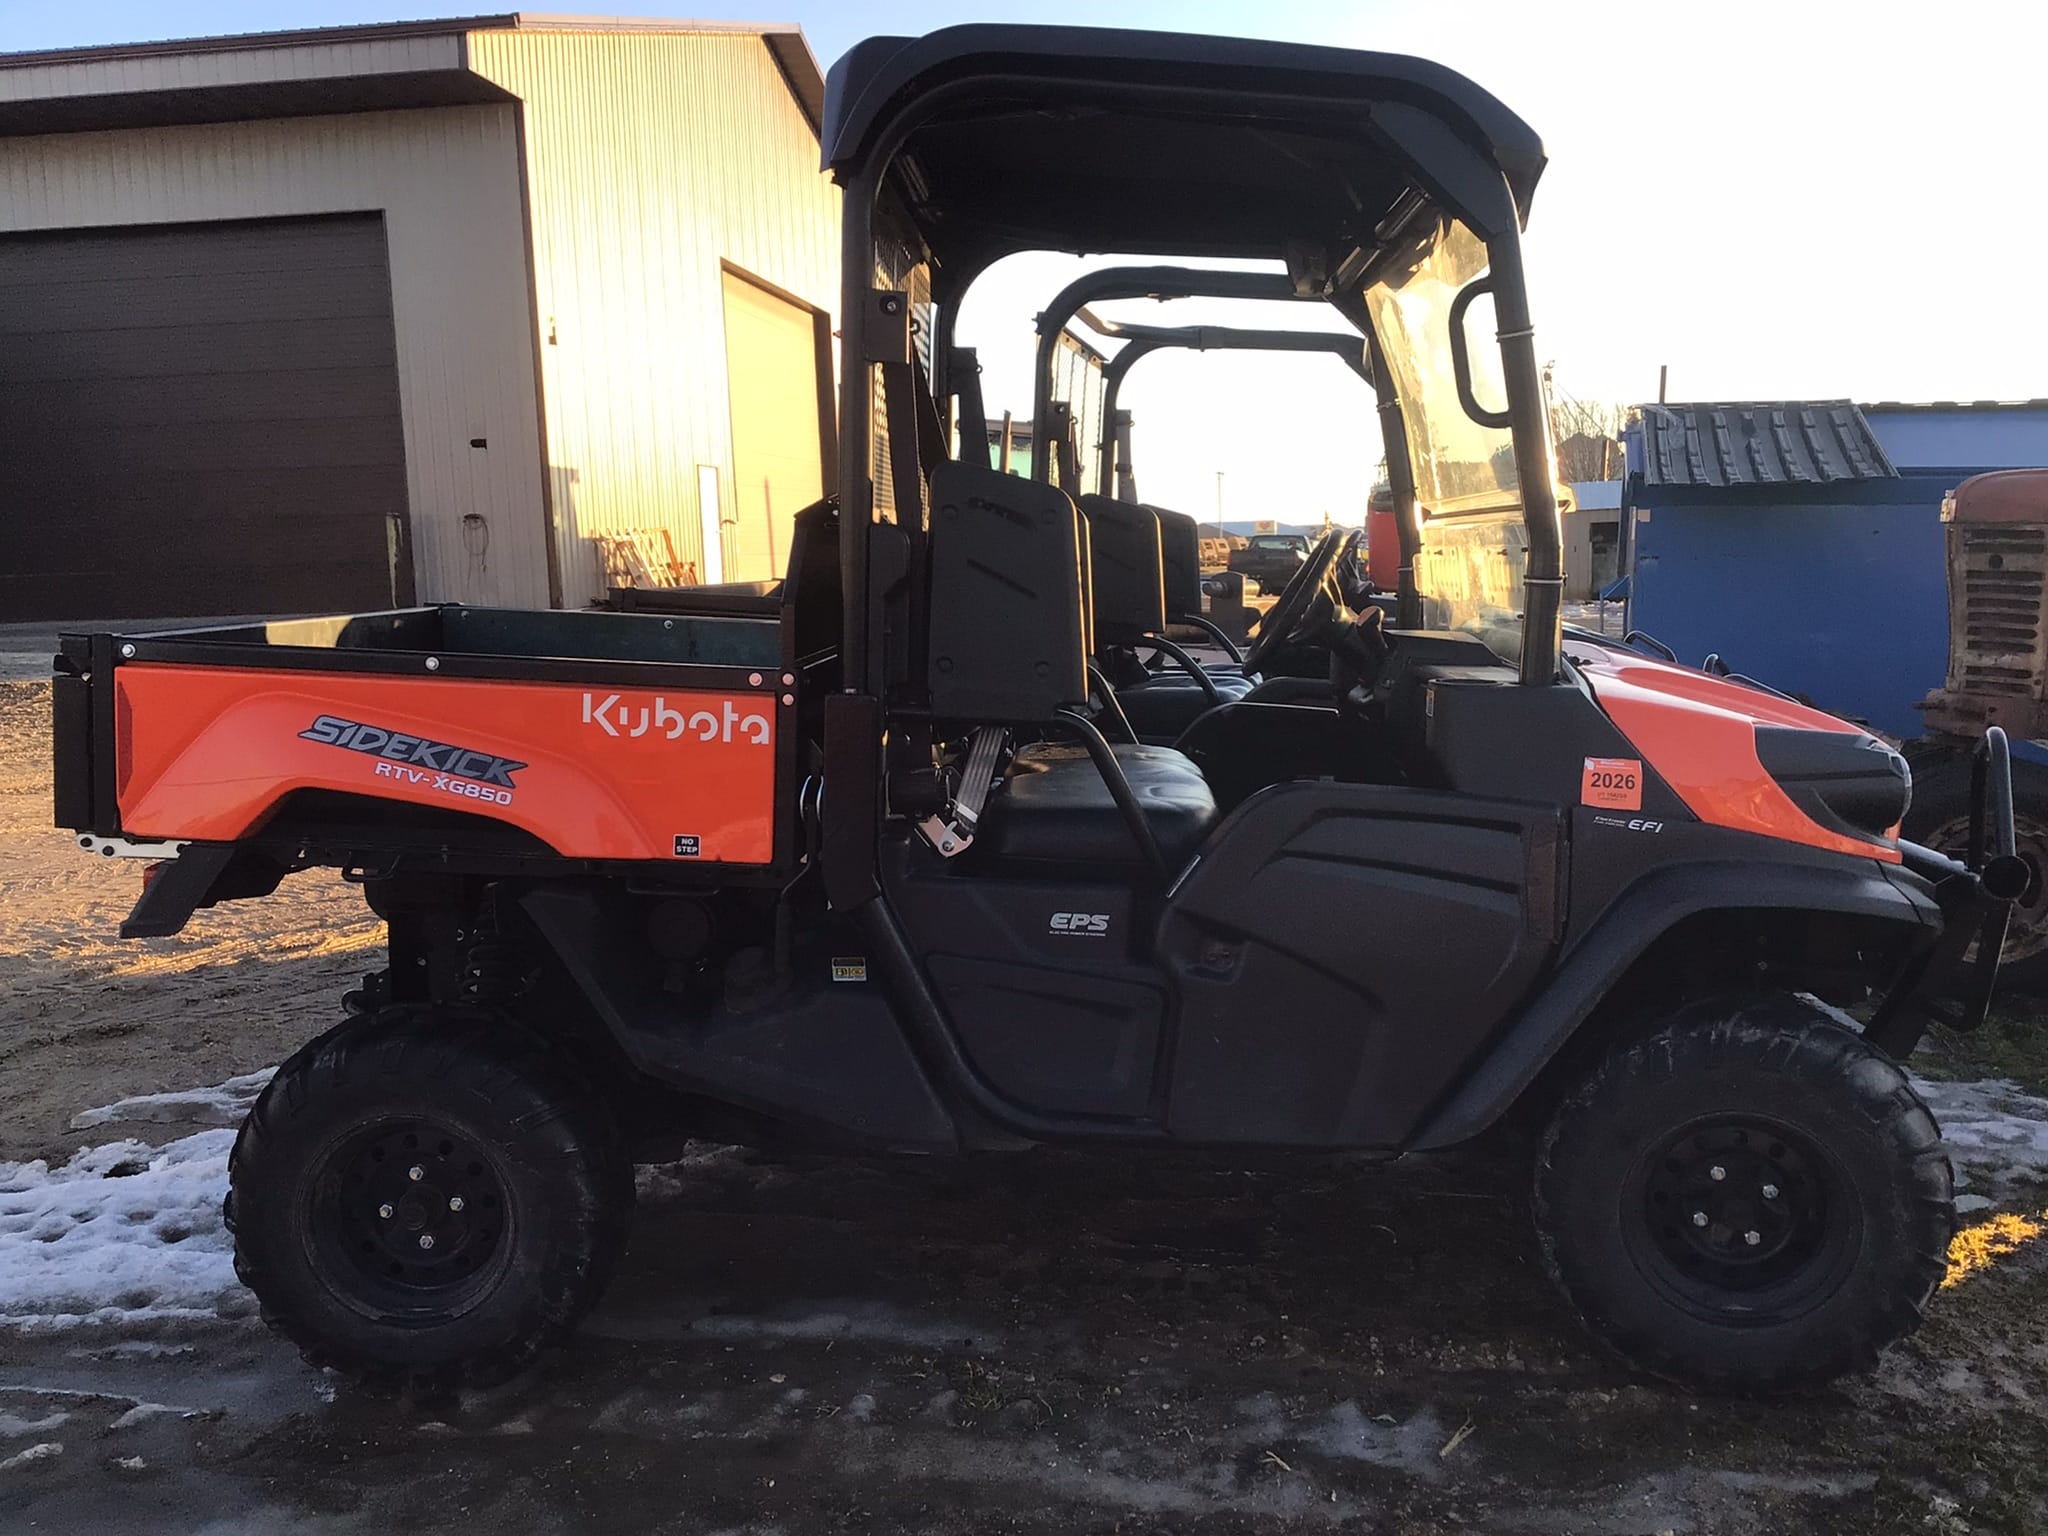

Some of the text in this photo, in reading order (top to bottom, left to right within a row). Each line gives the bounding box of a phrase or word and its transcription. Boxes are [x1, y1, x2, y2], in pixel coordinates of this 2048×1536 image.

[582, 693, 770, 745] Kubota
[298, 715, 528, 789] SIDEKICK
[375, 762, 513, 806] RTV-XG850
[1590, 772, 1636, 790] 2026
[1627, 819, 1664, 834] EFI
[676, 845, 698, 853] STEP
[681, 838, 694, 846] NO
[1050, 912, 1111, 931] EPS
